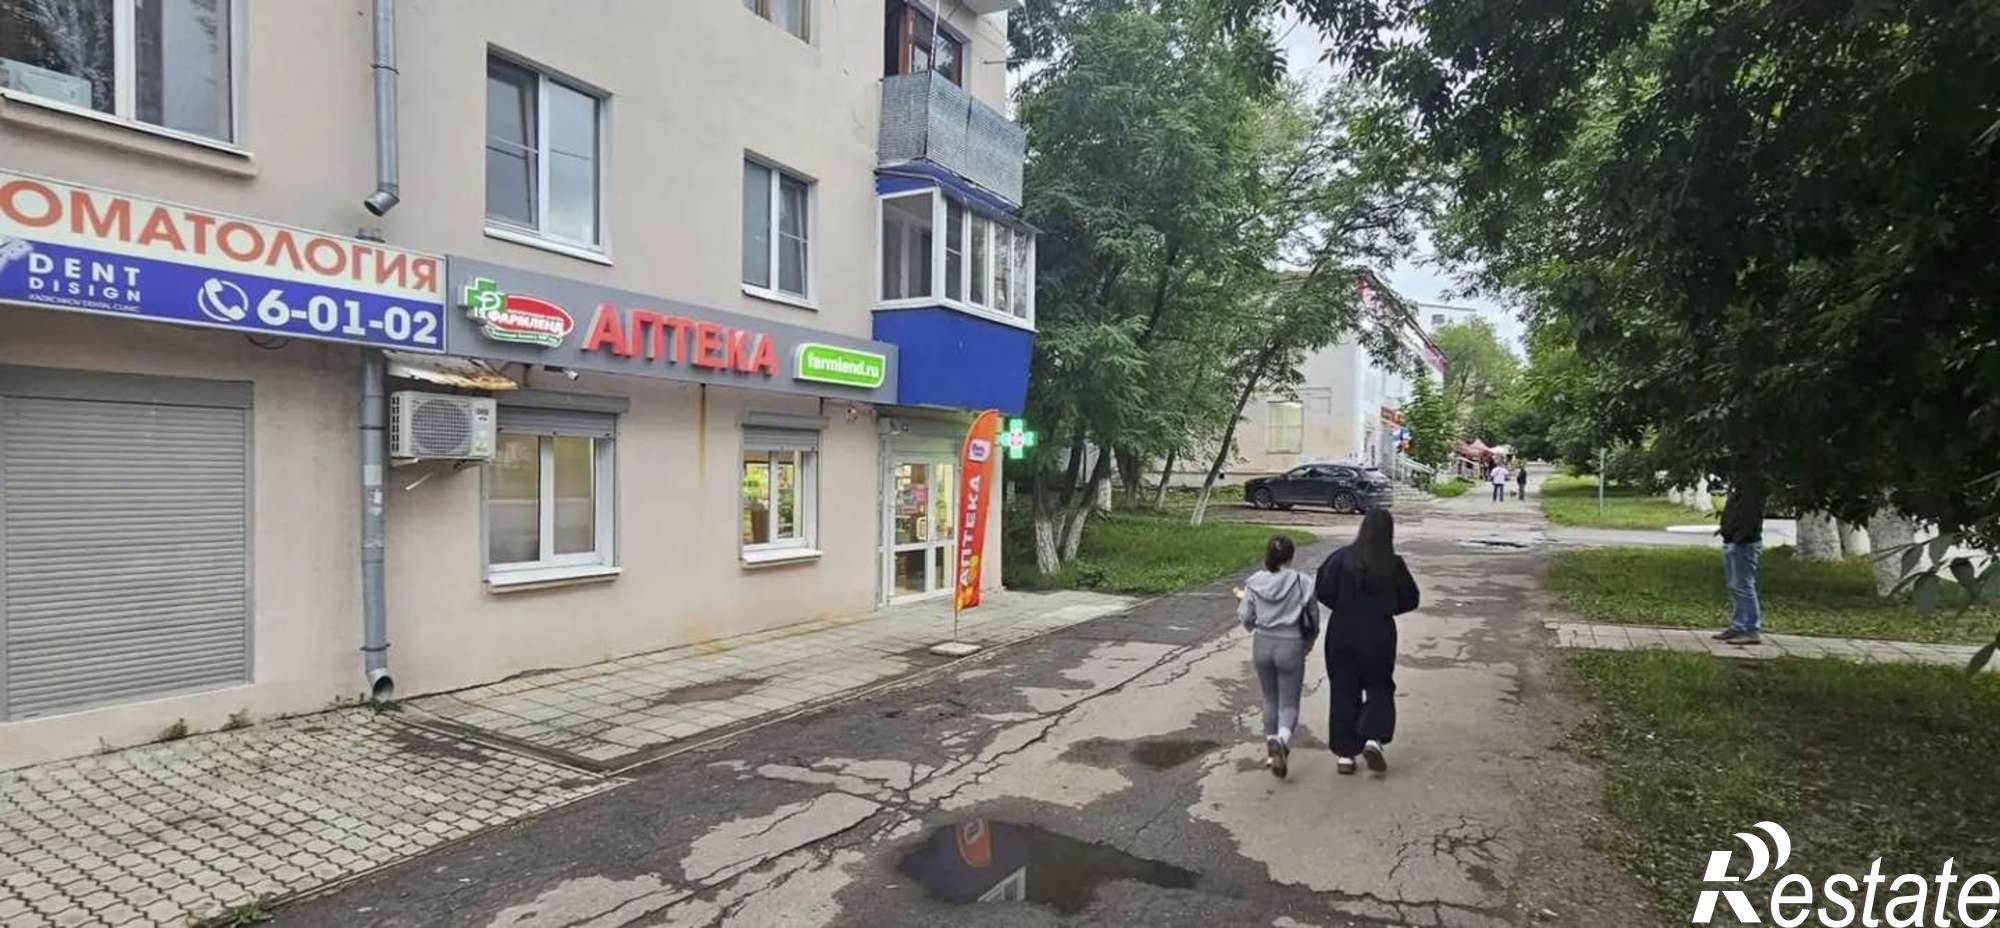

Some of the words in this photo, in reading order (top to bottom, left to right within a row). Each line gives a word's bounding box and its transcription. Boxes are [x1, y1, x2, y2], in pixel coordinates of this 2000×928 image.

[0, 180, 437, 293] ОМАТОЛОГИЯ
[28, 252, 140, 286] DENT
[28, 276, 141, 302] DISIGN
[257, 289, 438, 345] 6-01-02
[581, 301, 780, 378] АПТЕКА
[960, 474, 981, 587] АПТЕКА
